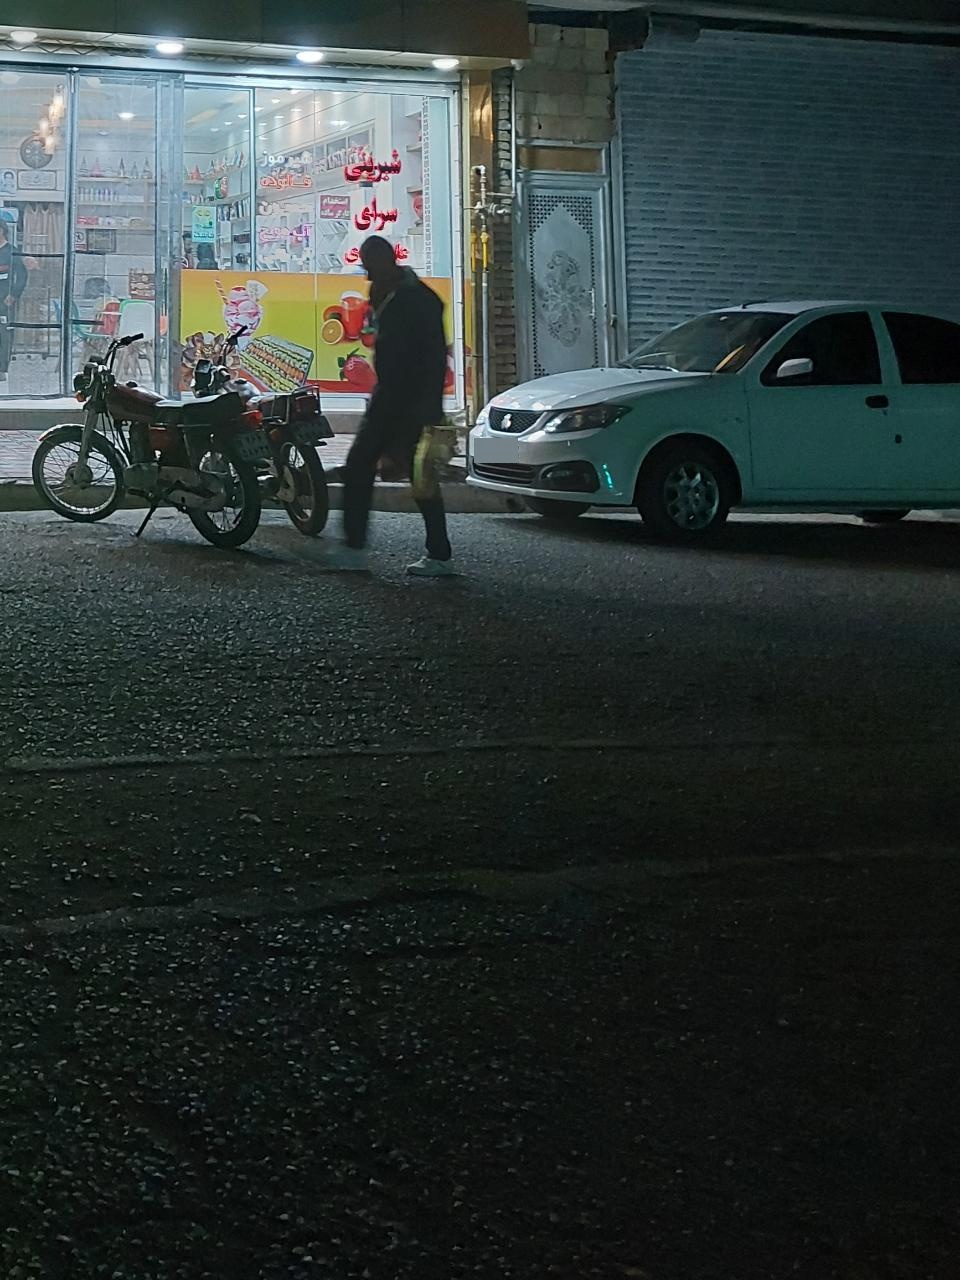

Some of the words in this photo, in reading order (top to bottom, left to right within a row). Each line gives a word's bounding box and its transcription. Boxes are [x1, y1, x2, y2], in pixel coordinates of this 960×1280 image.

[260, 150, 285, 167] موز
[344, 149, 401, 183] شیرینی
[354, 195, 398, 231] سرای
